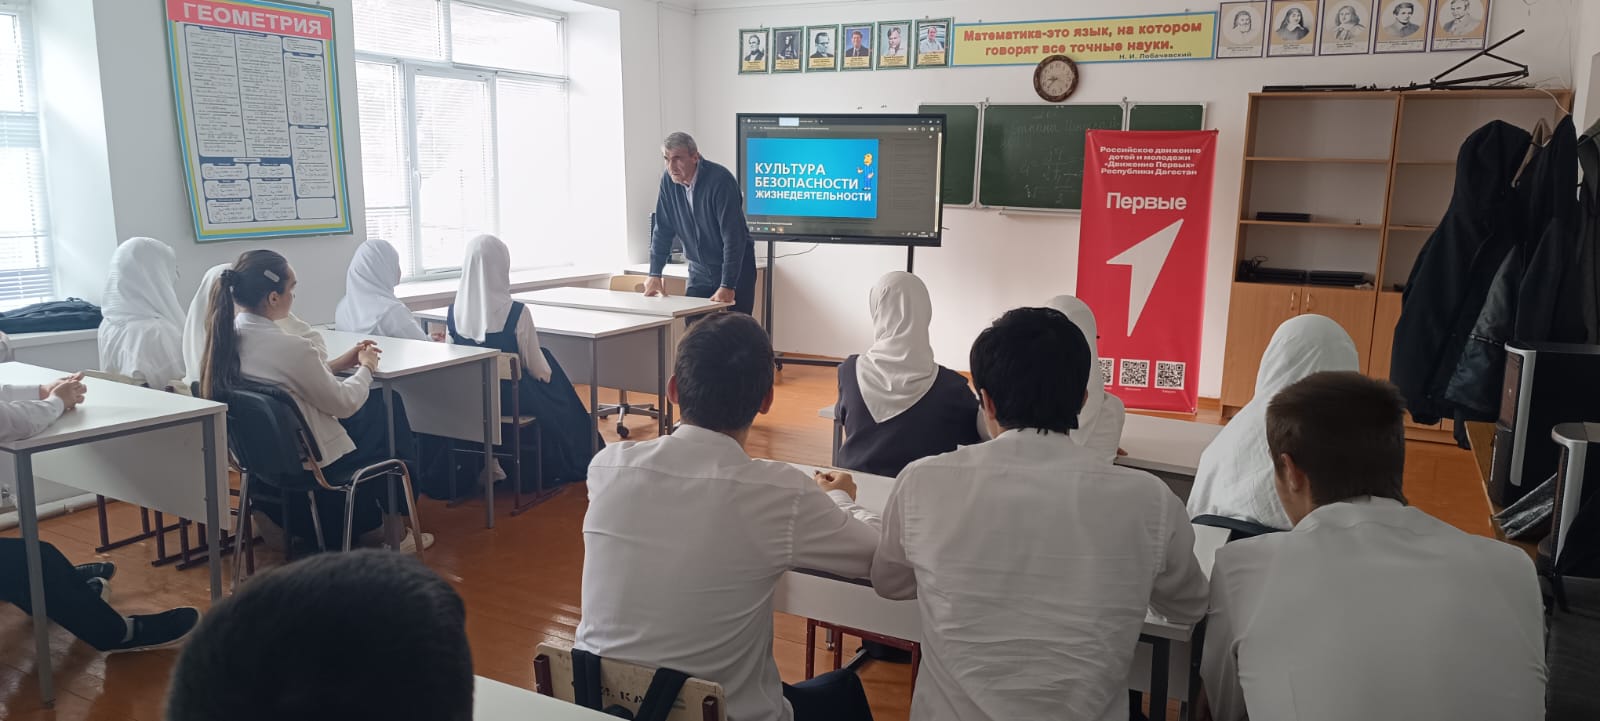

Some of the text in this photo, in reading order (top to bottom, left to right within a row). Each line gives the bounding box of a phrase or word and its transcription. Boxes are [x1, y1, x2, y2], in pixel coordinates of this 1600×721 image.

[183, 2, 322, 35] ГЕОМЕТРИЯ
[963, 22, 1203, 41] Математика-это язык, на котором
[985, 40, 1174, 57] говорят все точные науки.
[1100, 146, 1154, 154] Российское
[755, 162, 826, 175] КУЛЬТУРА
[1101, 167, 1154, 175] Республики
[755, 176, 859, 190] БЕЗОПАСНОСТИ
[755, 190, 872, 202] ЖИЗНЕДЕЯТЕЛЬНОСТИ
[1106, 192, 1187, 214] Первые
